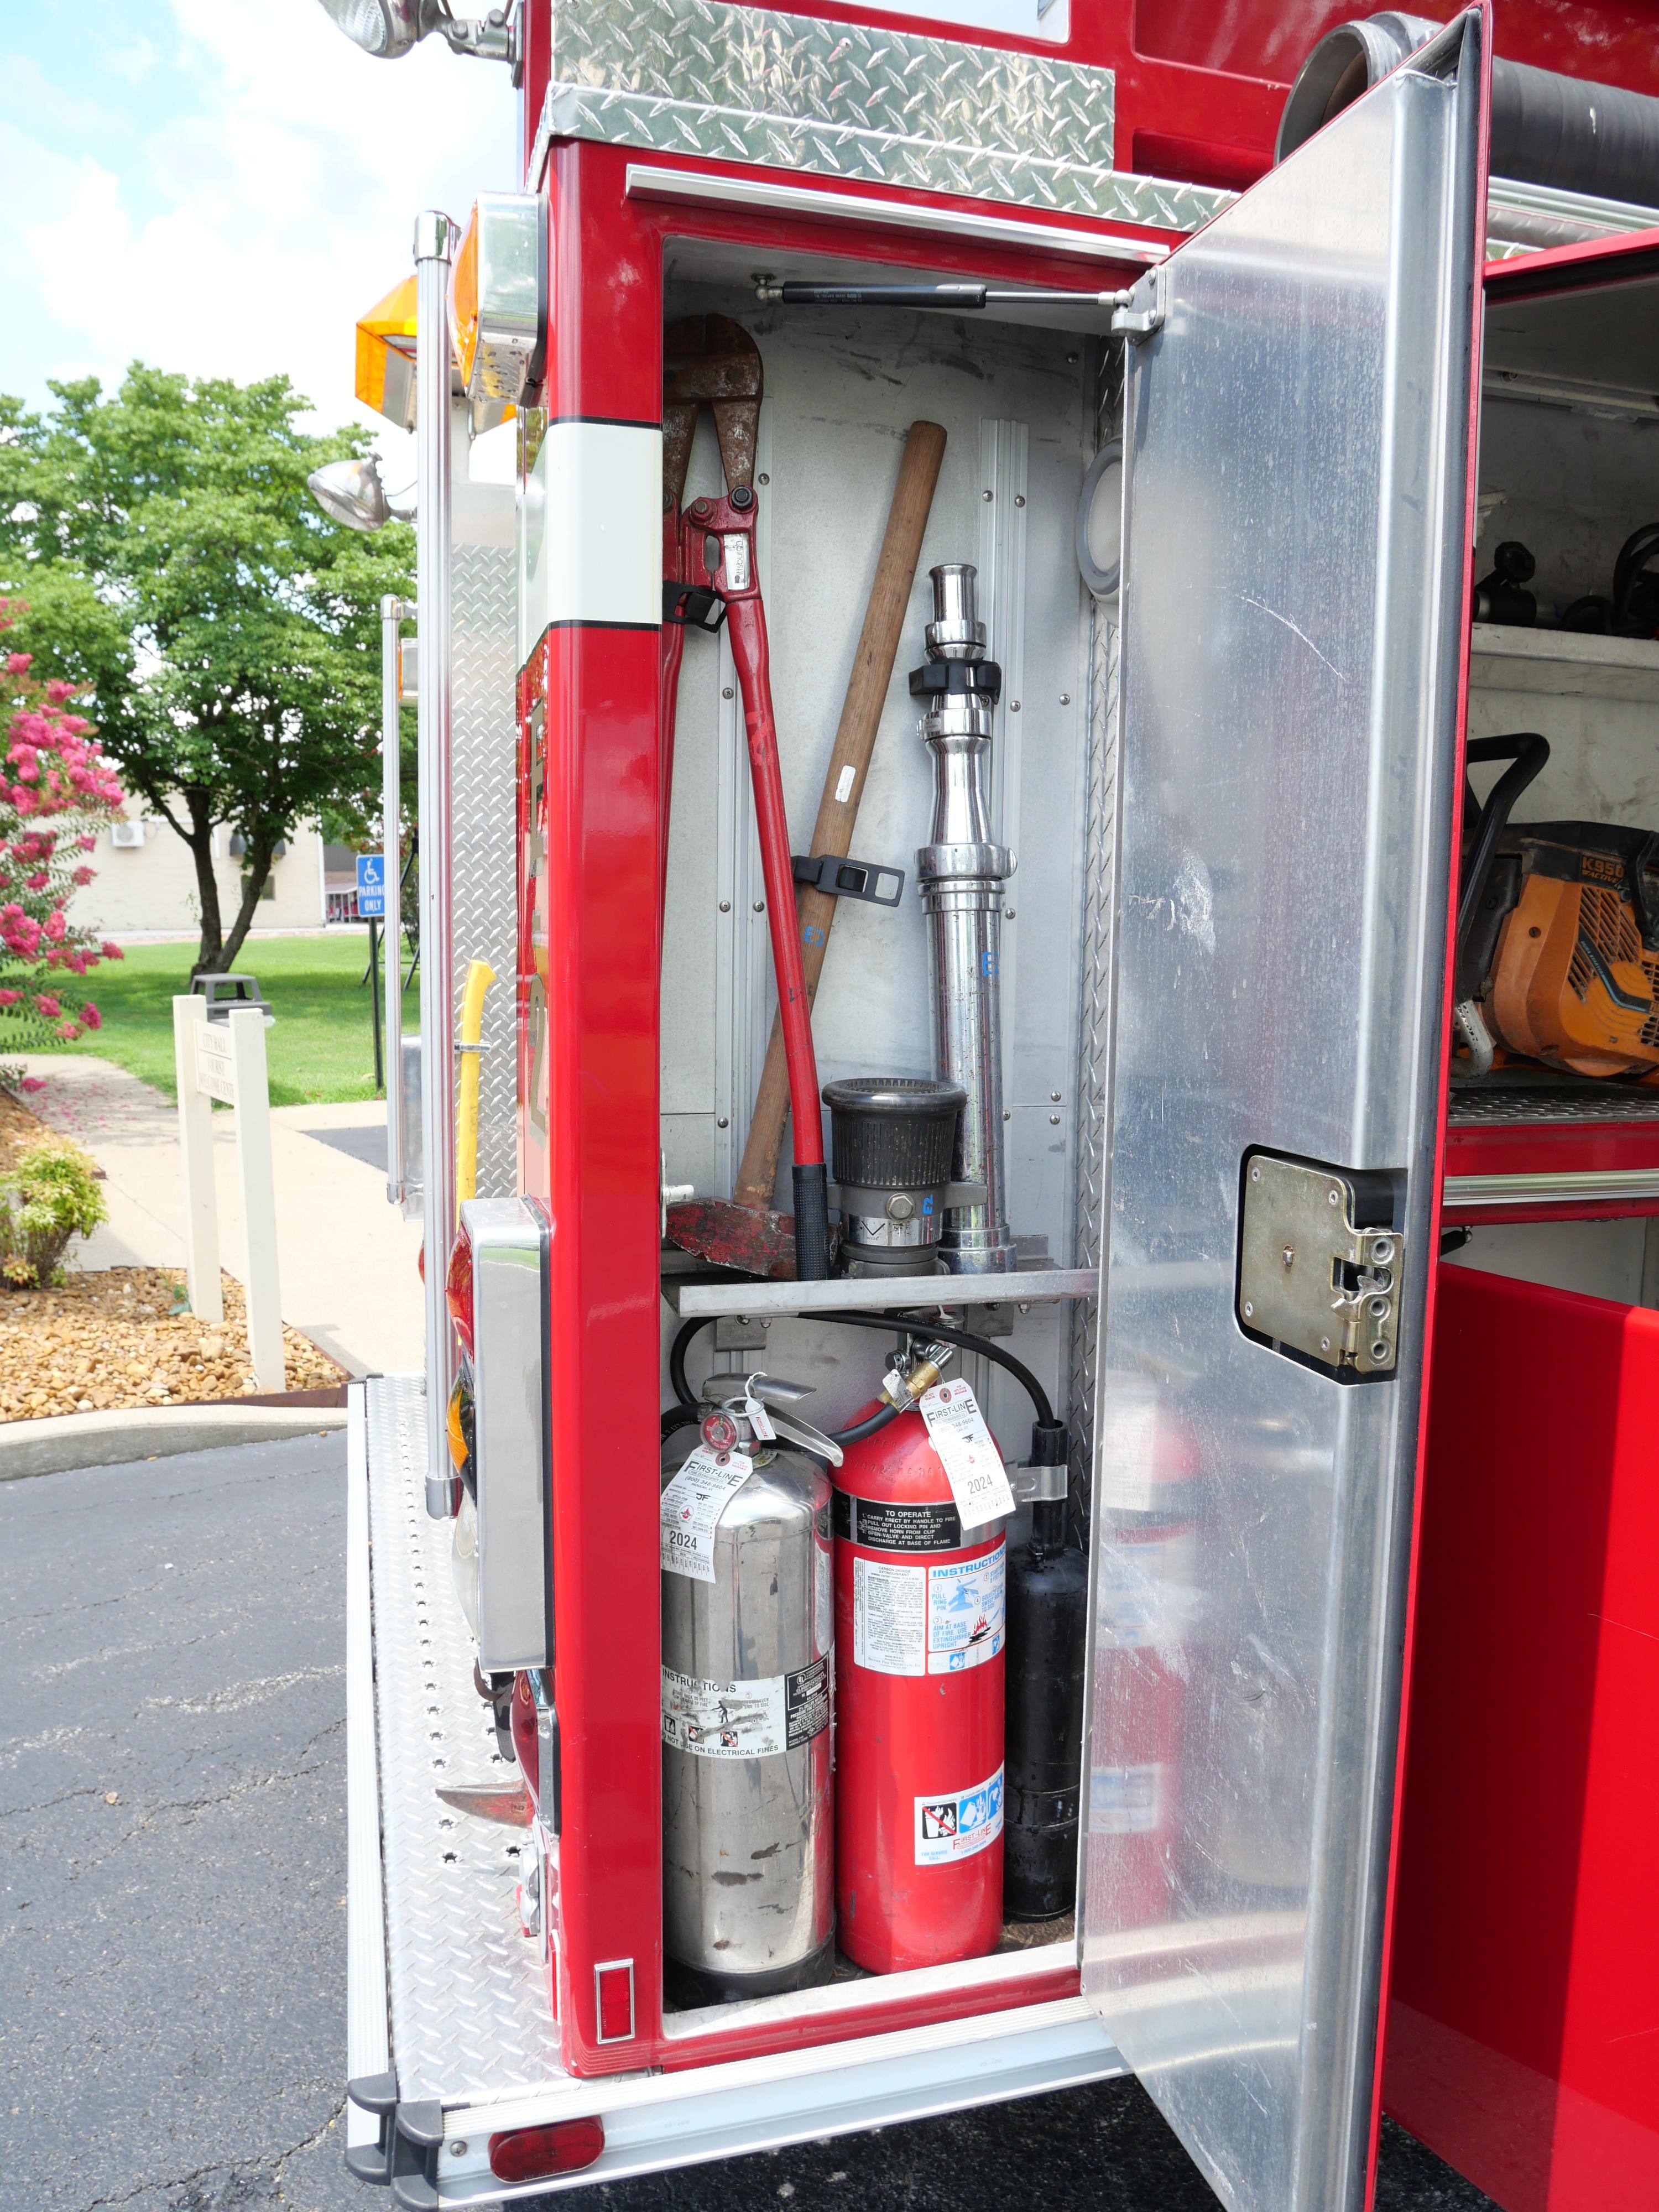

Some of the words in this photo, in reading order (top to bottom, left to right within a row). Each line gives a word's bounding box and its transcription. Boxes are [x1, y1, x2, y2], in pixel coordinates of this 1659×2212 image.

[735, 540, 745, 583] Pittsburgh
[1588, 870, 1618, 884] ACTIVE
[365, 899, 382, 912] ONLY
[221, 1080, 234, 1099] CENTE
[926, 1399, 977, 1427] FIRST-LINE
[952, 1417, 974, 1428] 348-9604
[684, 1460, 743, 1486] FIRST-LINE
[700, 1480, 726, 1490] 348-9604
[968, 1474, 993, 1494] 2024
[670, 1531, 697, 1550] 2024
[868, 1536, 896, 1545] DISCHARGE
[982, 1597, 993, 1608] SWEEP
[933, 1632, 971, 1644] EXTINGUISHER
[667, 1734, 679, 1745] NOT
[708, 1747, 755, 1756] ELECTRICAL
[757, 1745, 779, 1754] FIRES
[953, 1823, 991, 1850] FIRST-LINE
